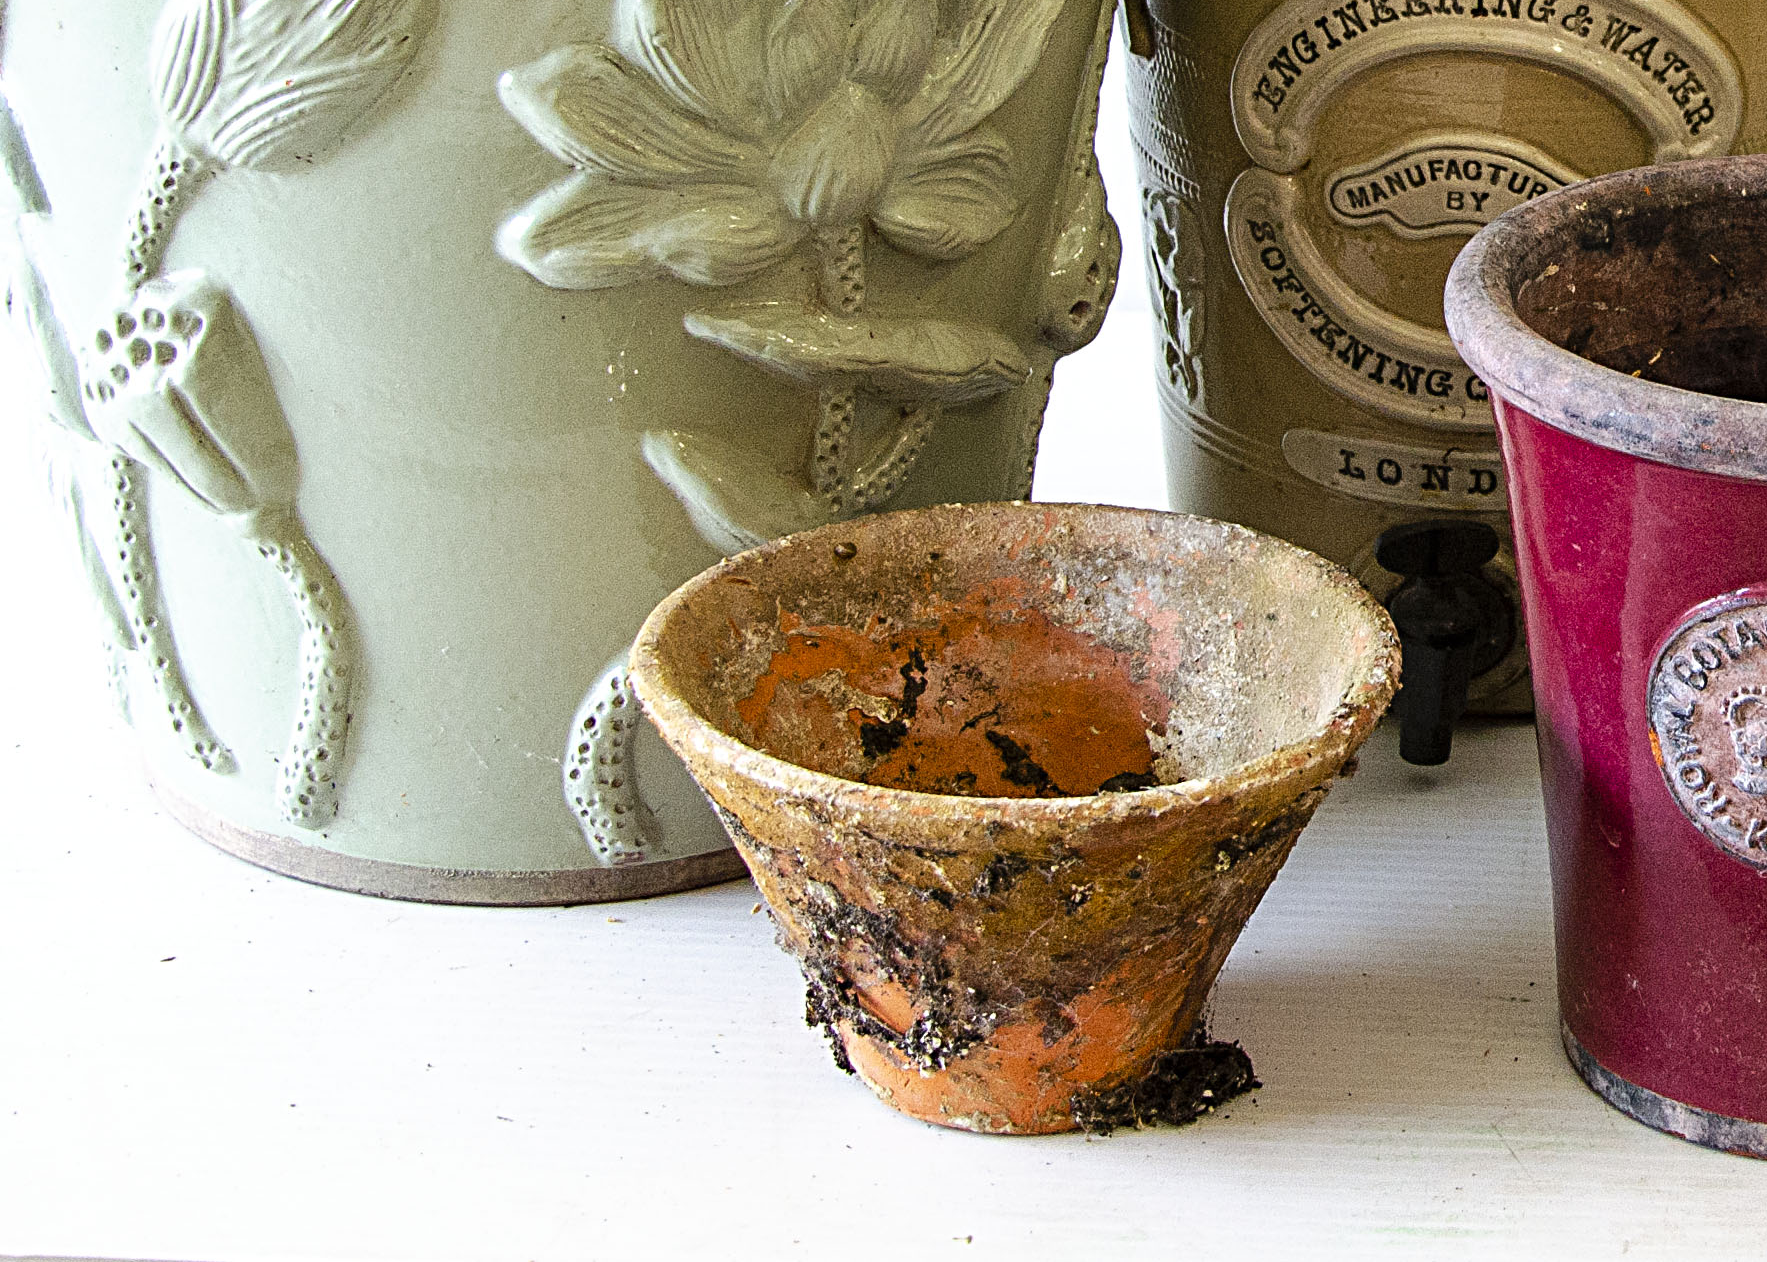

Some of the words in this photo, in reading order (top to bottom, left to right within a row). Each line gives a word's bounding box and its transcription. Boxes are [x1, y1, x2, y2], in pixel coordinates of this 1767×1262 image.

[1561, 5, 1593, 38] &
[1599, 15, 1716, 136] WATER
[1346, 159, 1549, 210] MANUFACTUR
[1445, 191, 1491, 212] BY
[1247, 219, 1454, 397] SOFTENING
[1339, 448, 1498, 495] LOND
